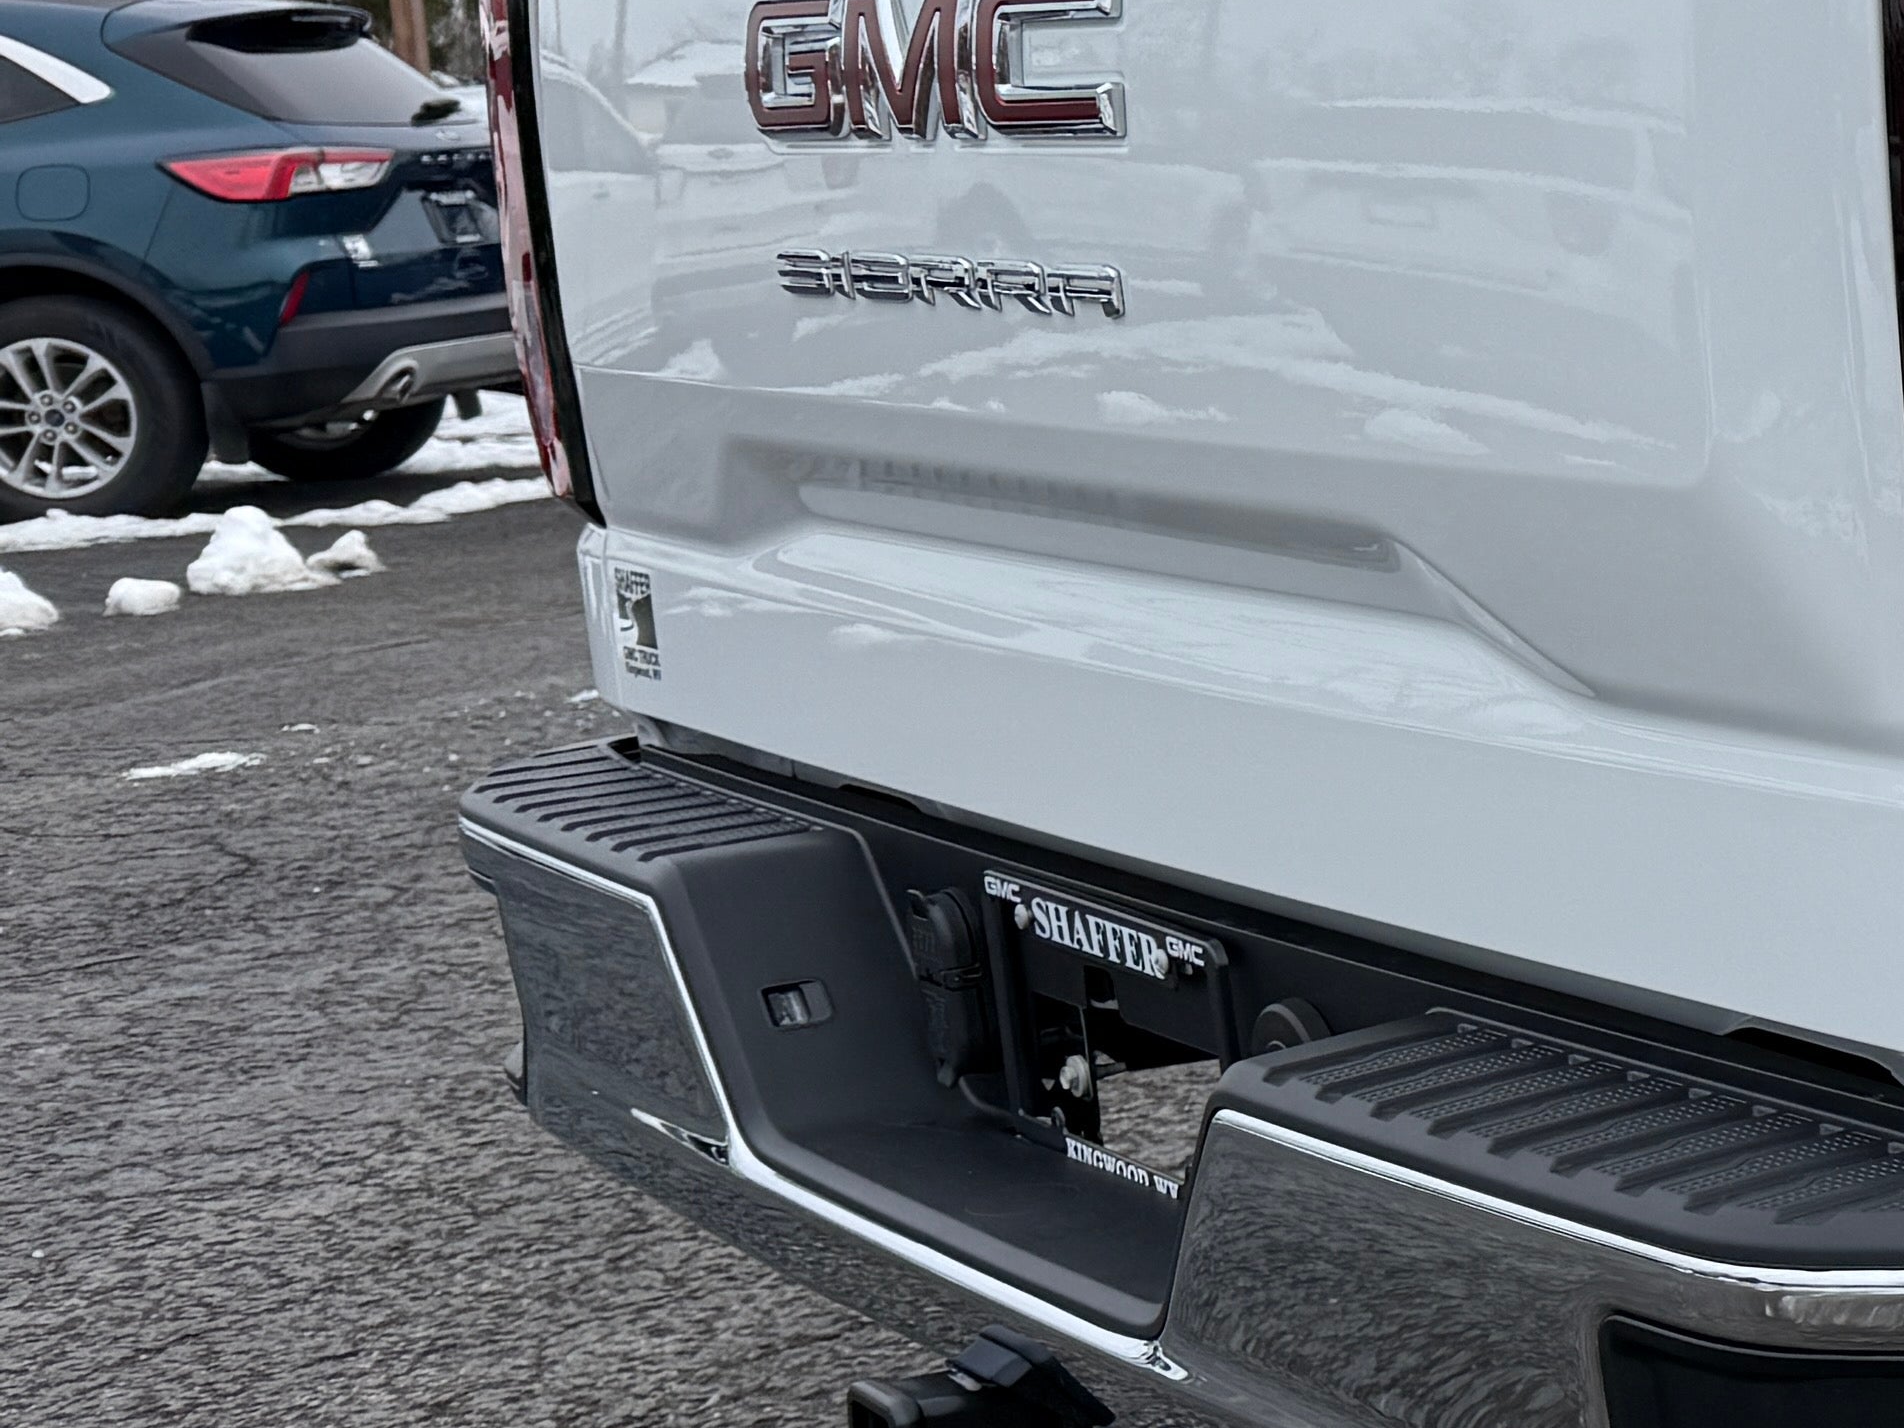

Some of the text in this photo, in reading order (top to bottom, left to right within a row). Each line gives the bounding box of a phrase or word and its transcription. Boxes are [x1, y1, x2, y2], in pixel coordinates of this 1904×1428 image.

[776, 248, 1126, 319] SIERRA
[984, 875, 1205, 980] GMC SHAFFER GMC
[1065, 1136, 1179, 1200] KINGWOOD WV
